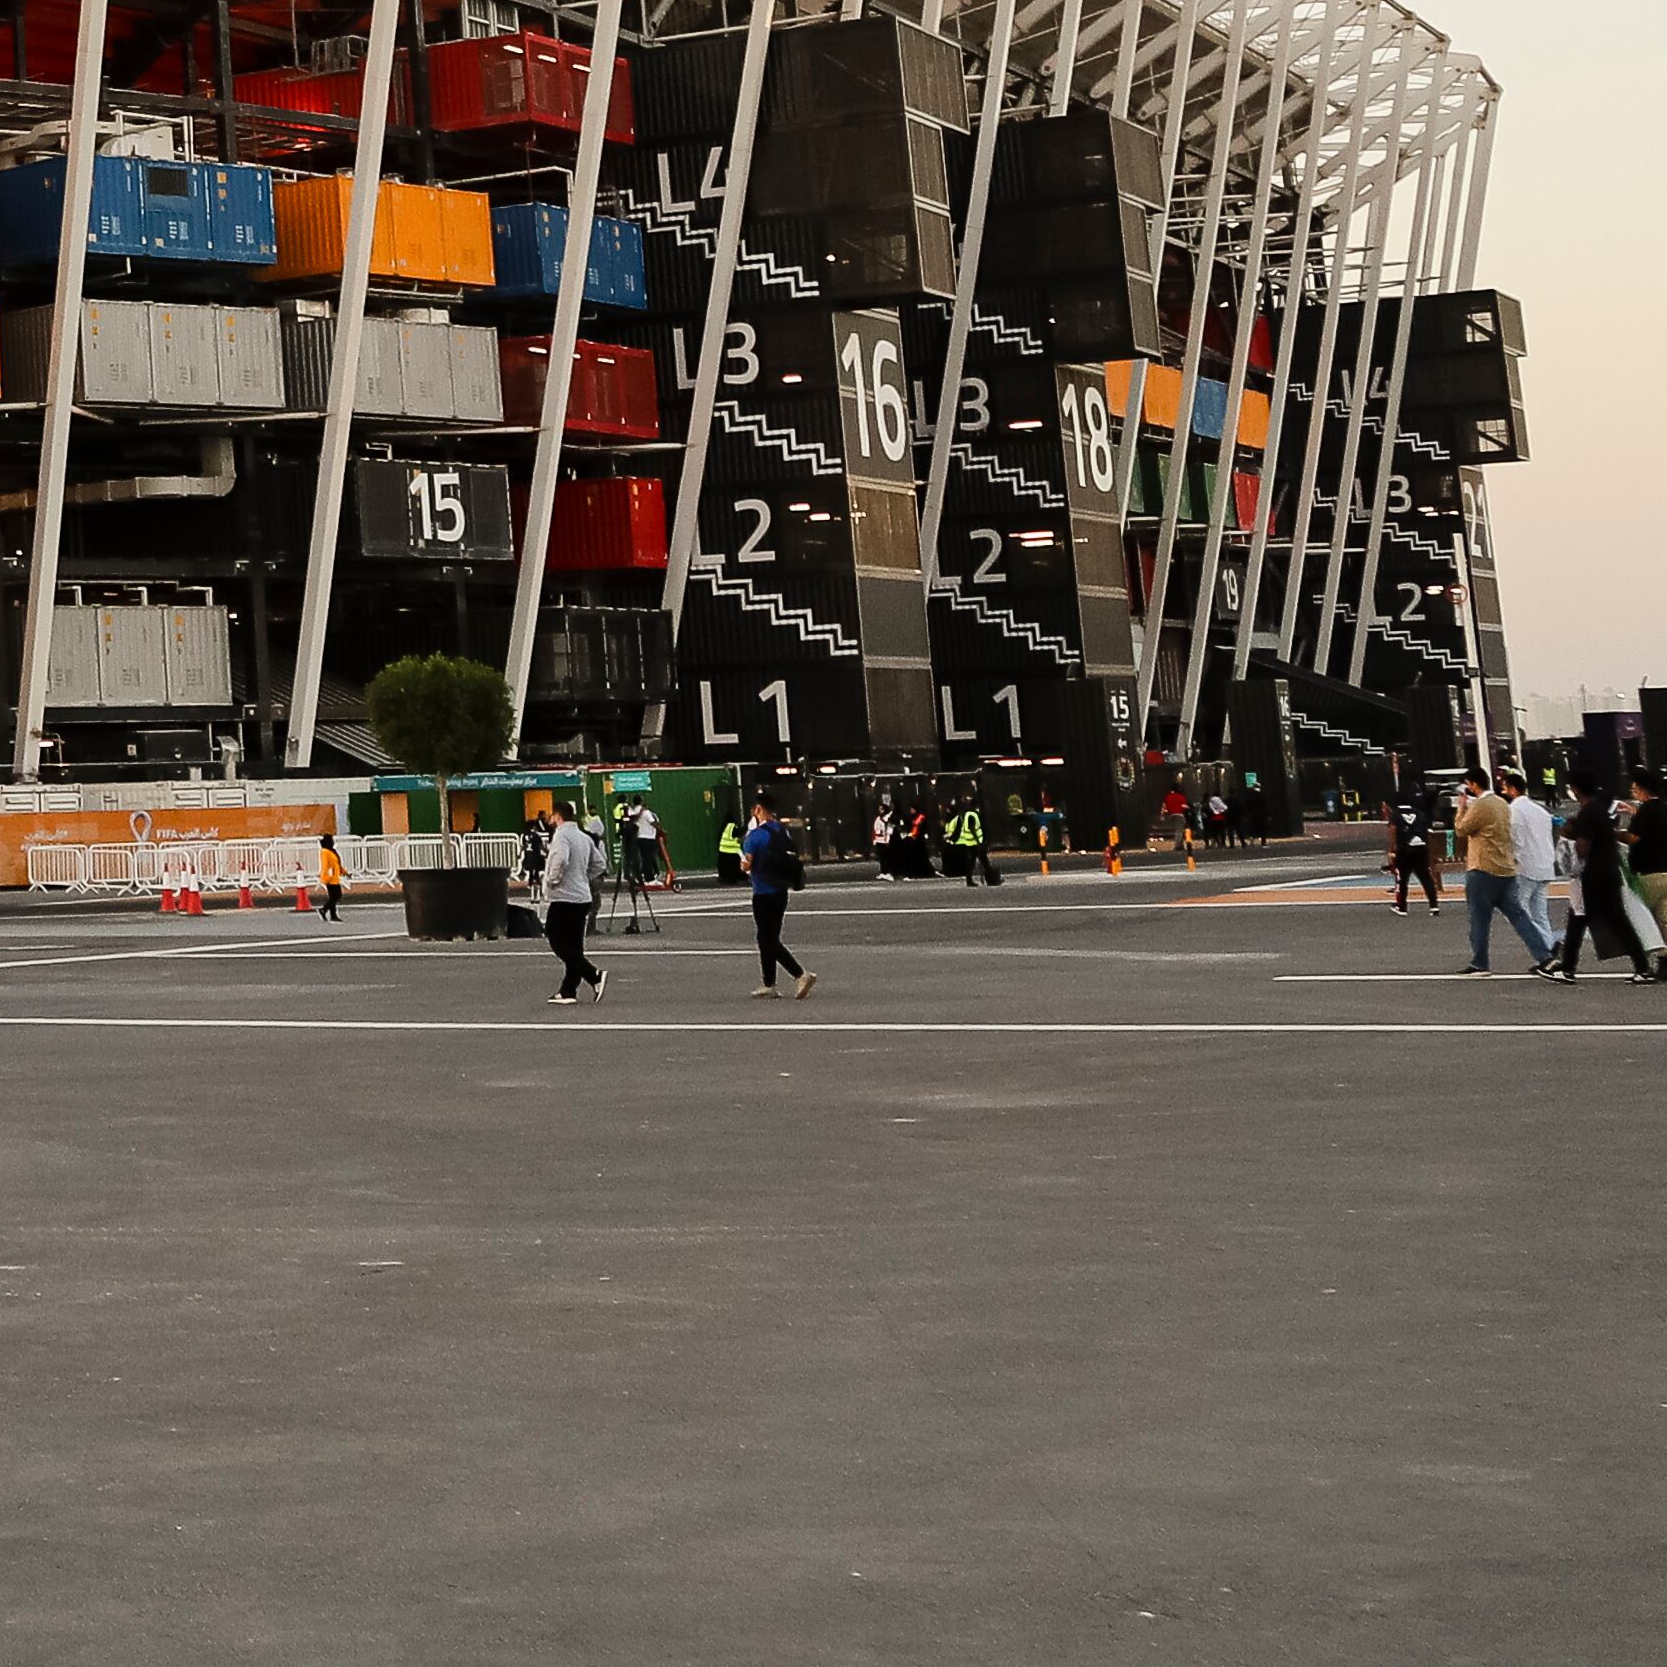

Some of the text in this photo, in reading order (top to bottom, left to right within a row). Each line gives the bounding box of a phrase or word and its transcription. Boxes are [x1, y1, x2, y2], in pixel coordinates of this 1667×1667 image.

[672, 322, 761, 391] L3
[840, 332, 909, 464] 16
[912, 377, 991, 438] L3
[1062, 382, 1114, 493] 18
[409, 472, 465, 542] 15
[1222, 568, 1240, 611] 19
[698, 679, 790, 745] L1
[941, 684, 1023, 742] L1
[1109, 695, 1130, 720] 15
[156, 829, 178, 839] FIFA
